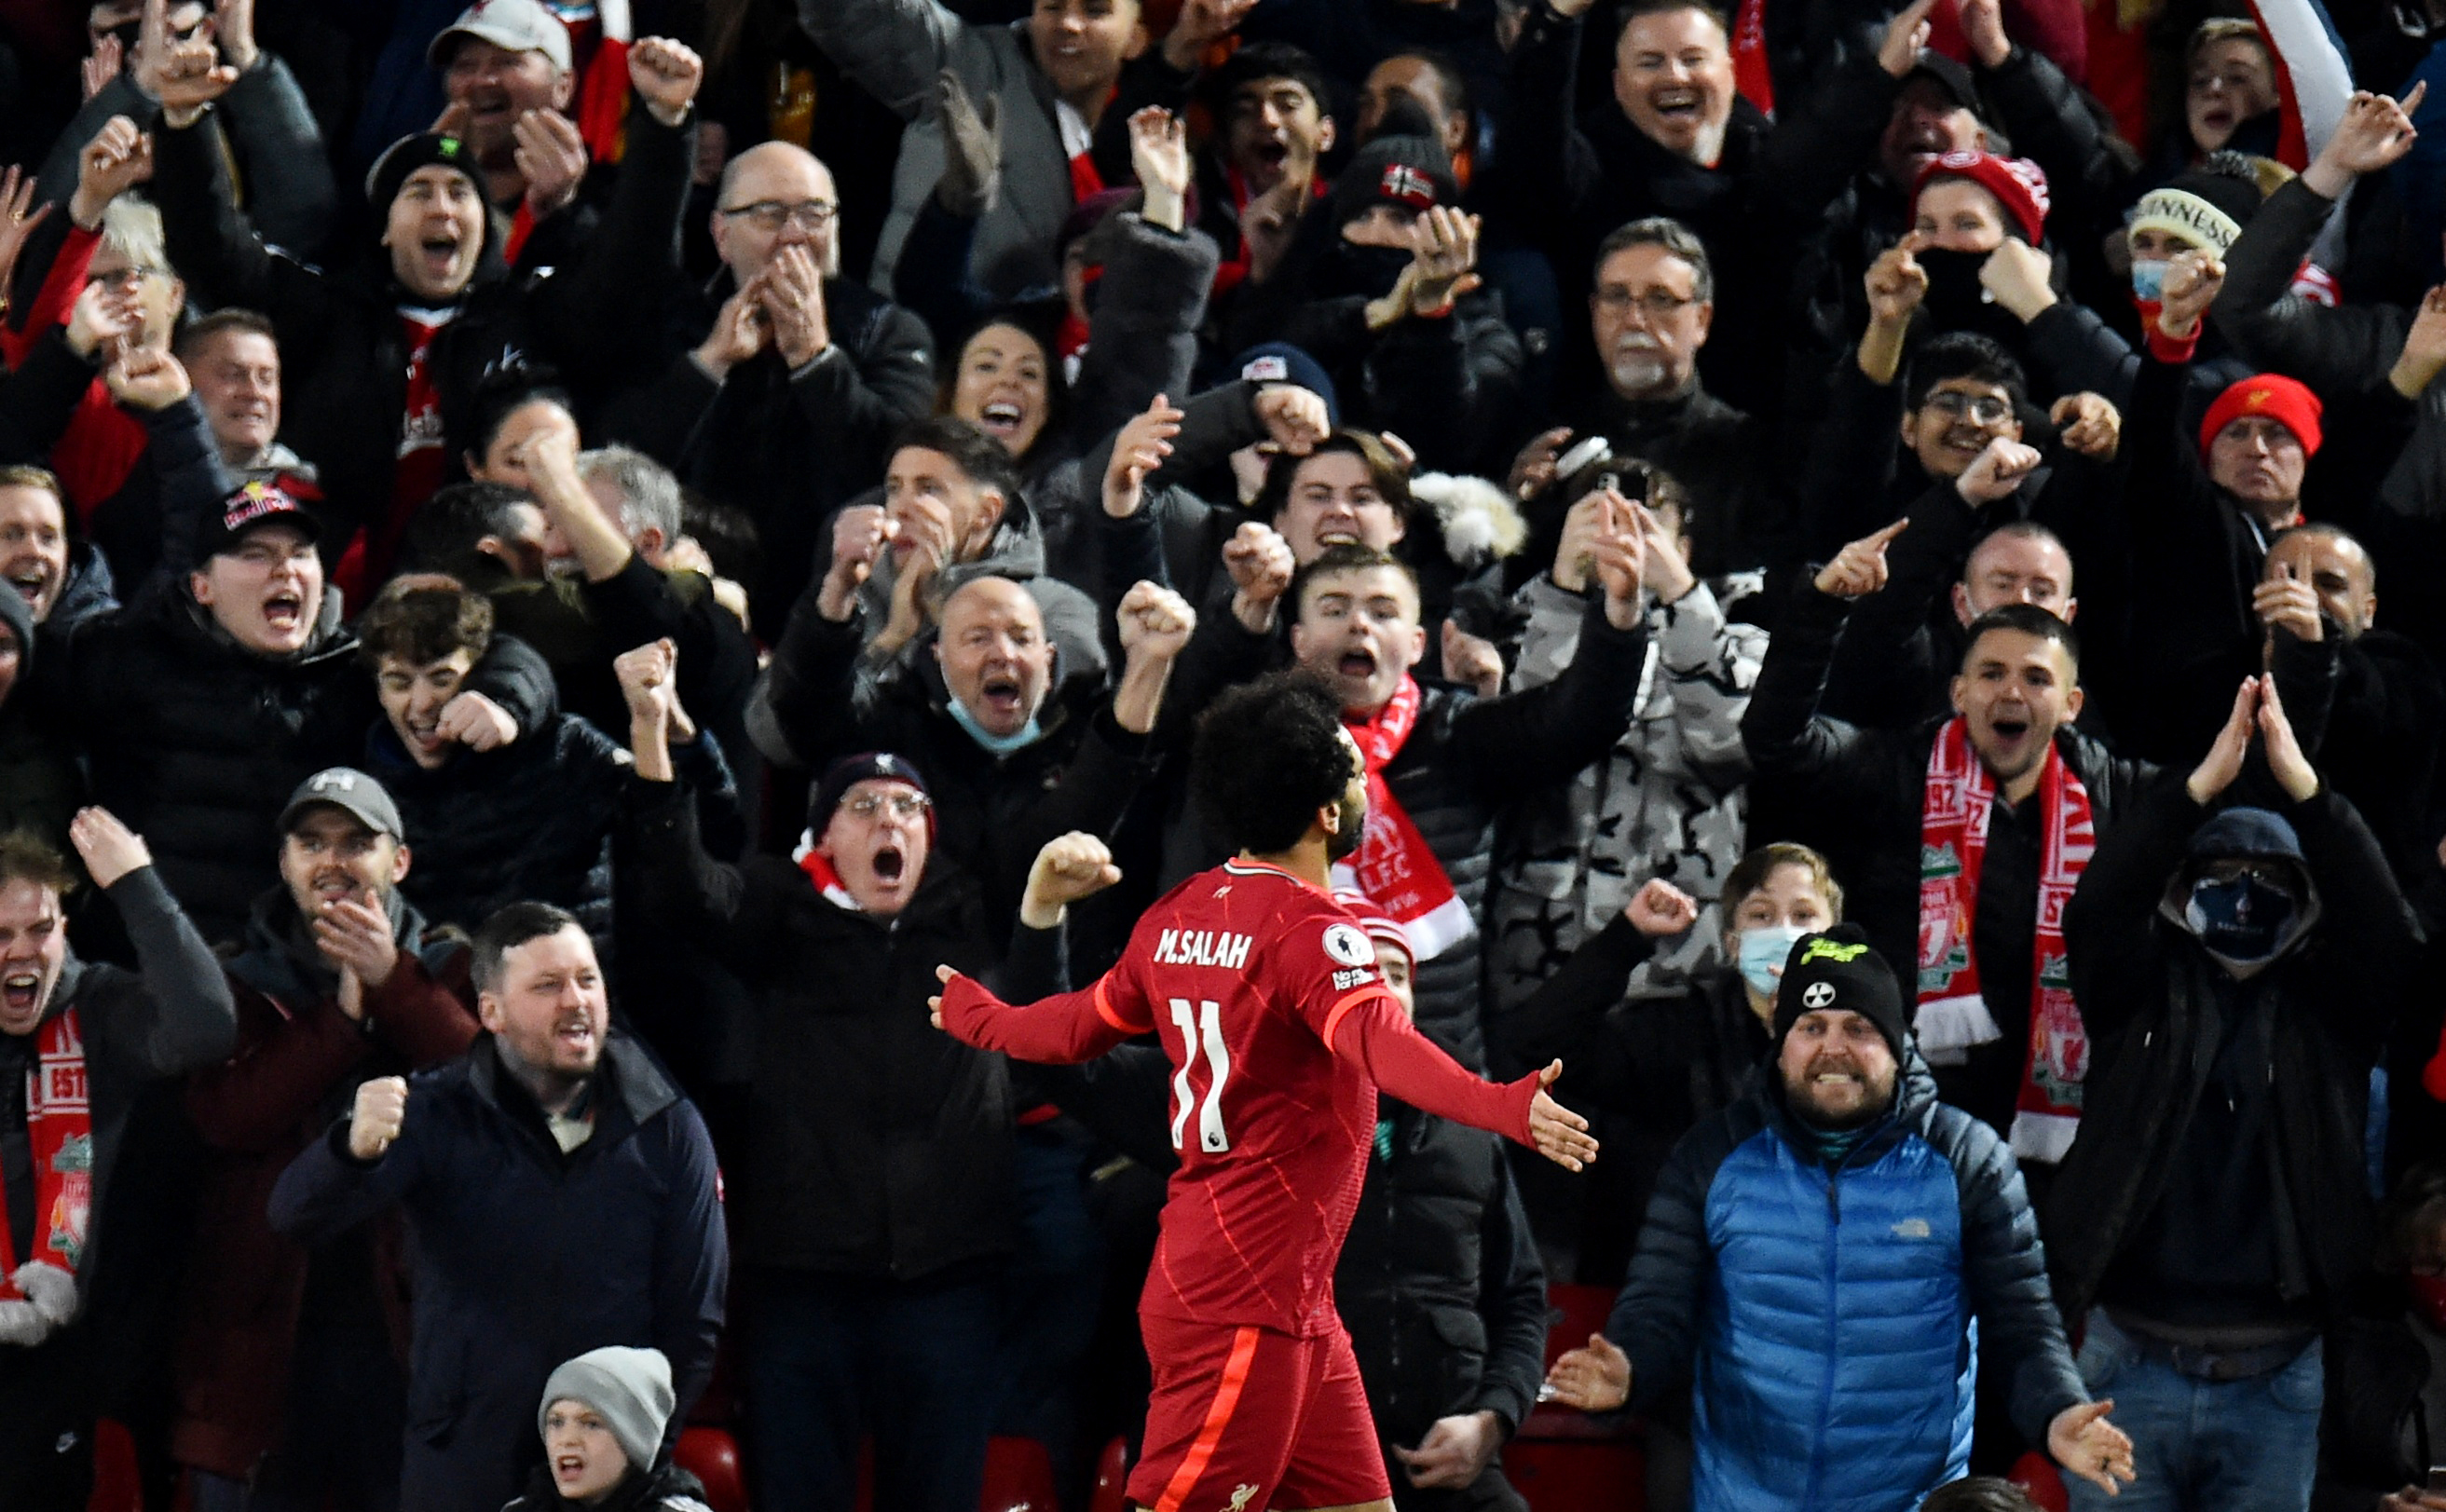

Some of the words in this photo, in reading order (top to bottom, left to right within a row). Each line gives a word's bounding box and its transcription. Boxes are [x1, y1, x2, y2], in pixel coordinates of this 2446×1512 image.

[1153, 928, 1253, 970] M.SALAH
[51, 1068, 86, 1098] EST
[1168, 998, 1230, 1153] 11
